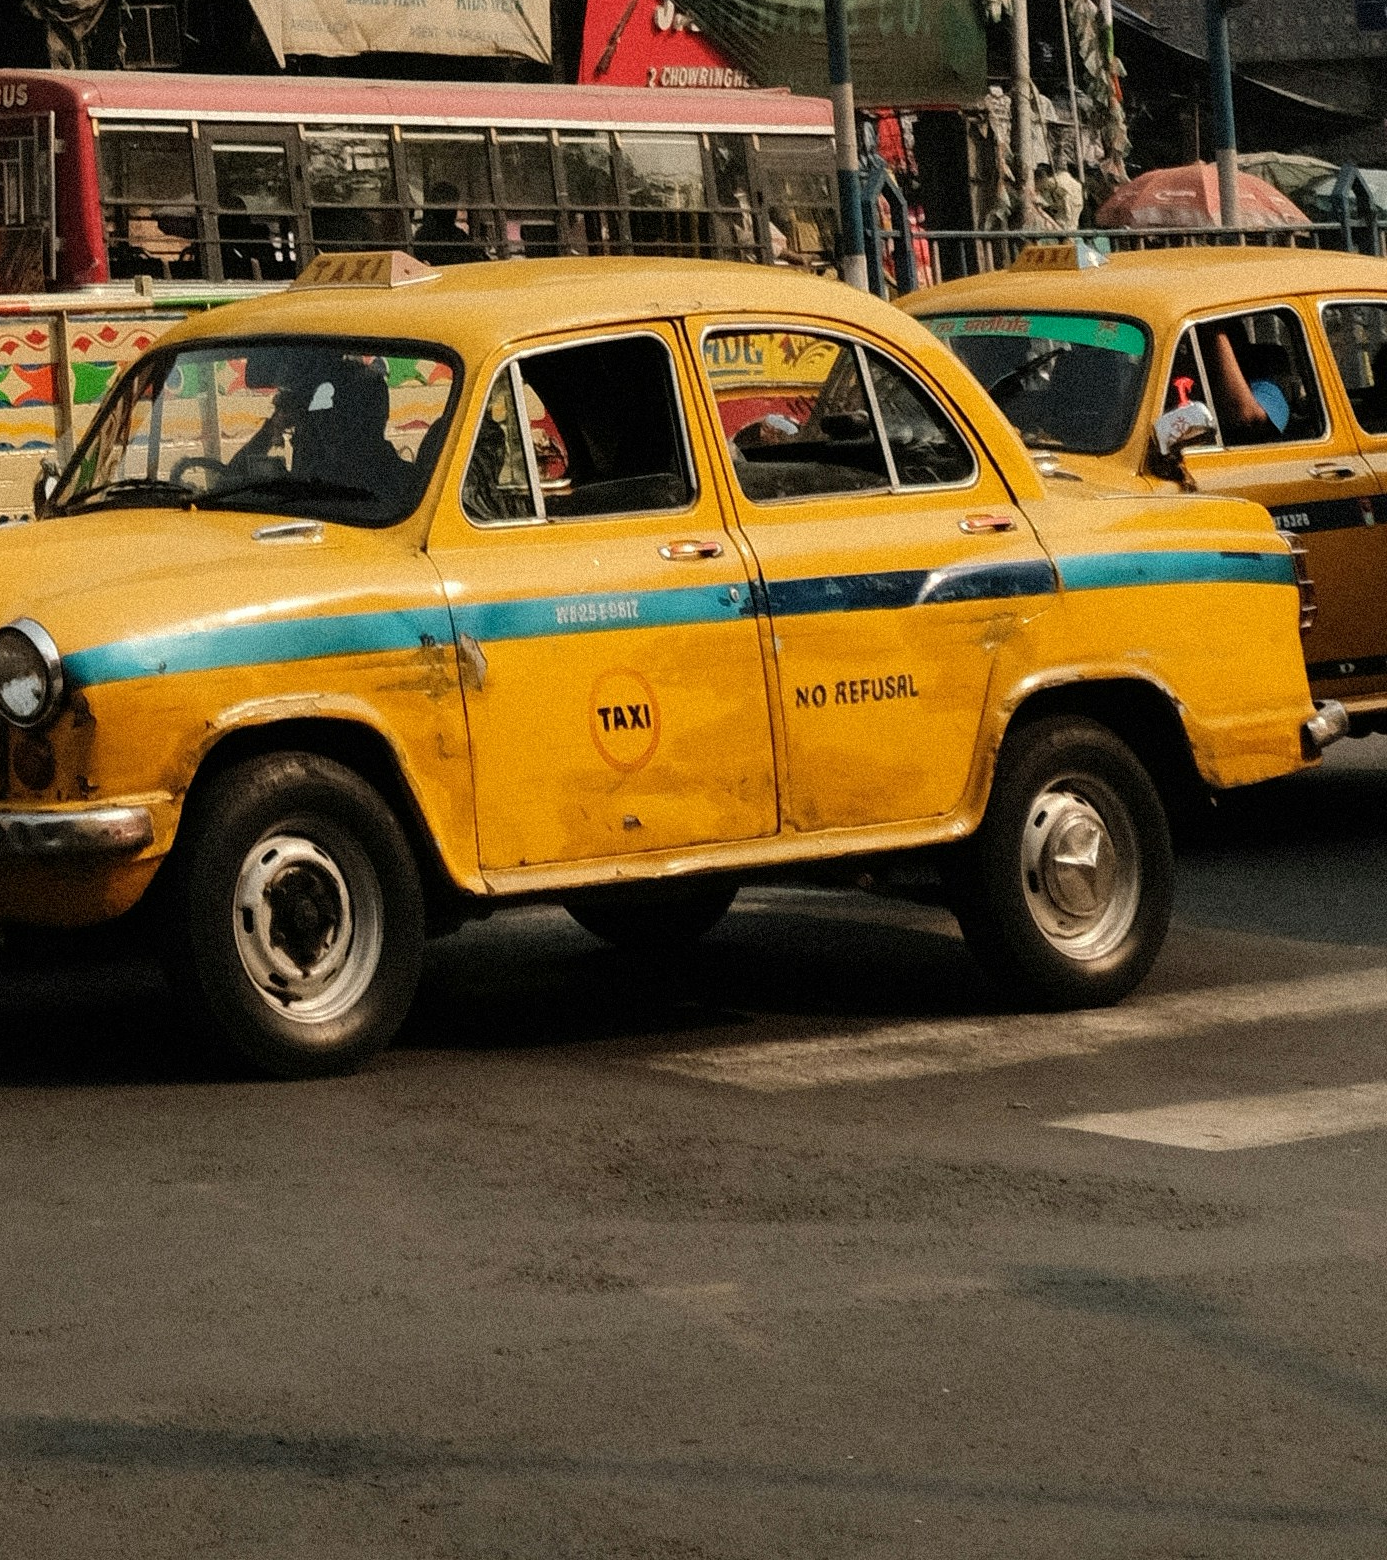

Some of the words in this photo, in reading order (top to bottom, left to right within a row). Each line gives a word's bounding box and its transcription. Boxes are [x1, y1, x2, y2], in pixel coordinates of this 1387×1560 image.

[314, 258, 384, 283] TAXI
[795, 684, 827, 709] NO
[835, 673, 920, 706] REFUSAL
[597, 704, 652, 733] TAXI
